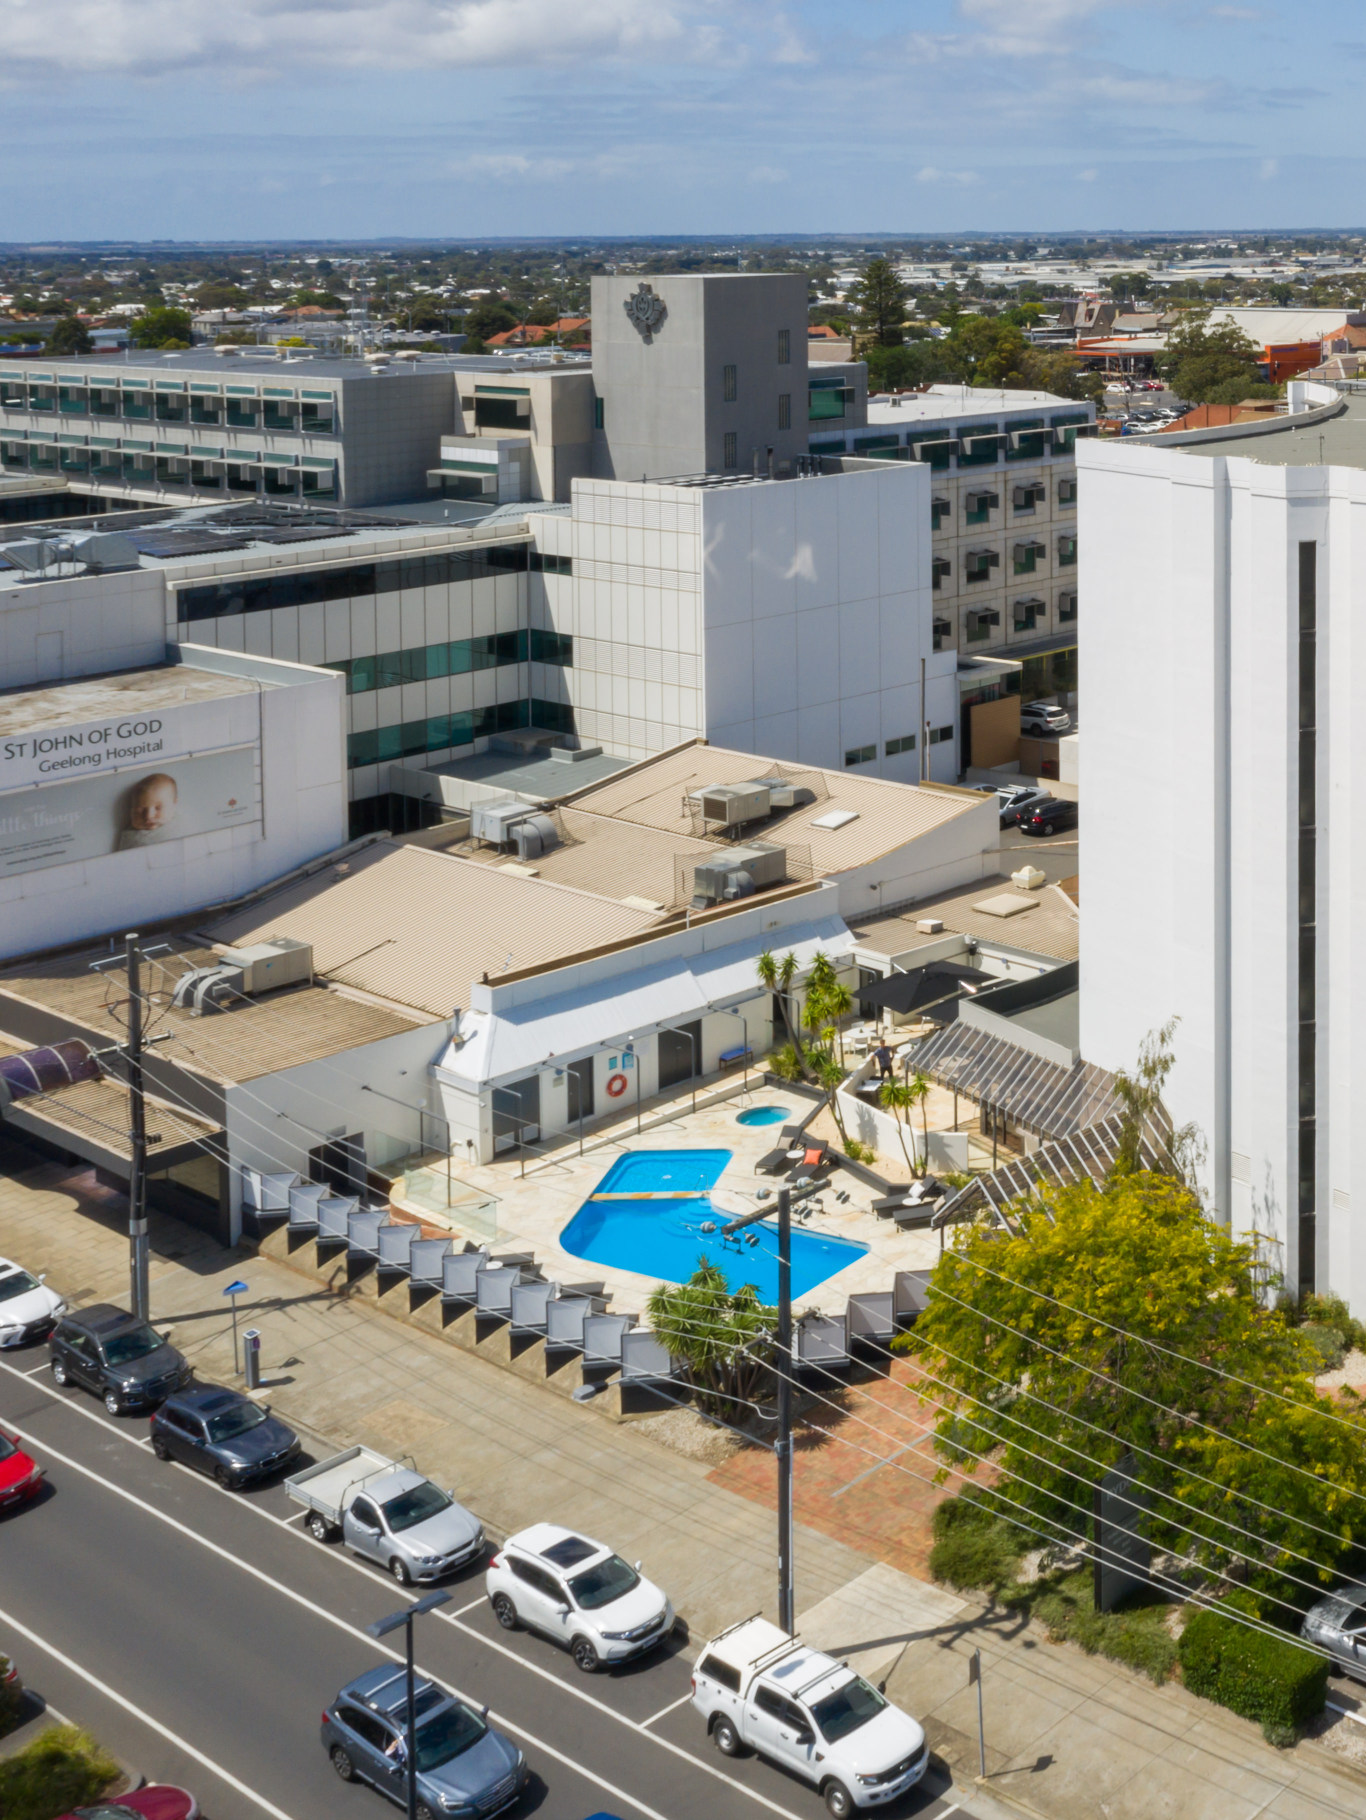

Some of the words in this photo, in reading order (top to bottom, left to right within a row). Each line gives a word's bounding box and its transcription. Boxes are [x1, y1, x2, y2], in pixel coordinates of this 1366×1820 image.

[4, 742, 28, 760] ST
[32, 732, 83, 759] JOHN
[88, 727, 112, 744] OF
[116, 719, 163, 739] GOD
[38, 753, 102, 773] Geelong
[106, 738, 163, 760] Hospital
